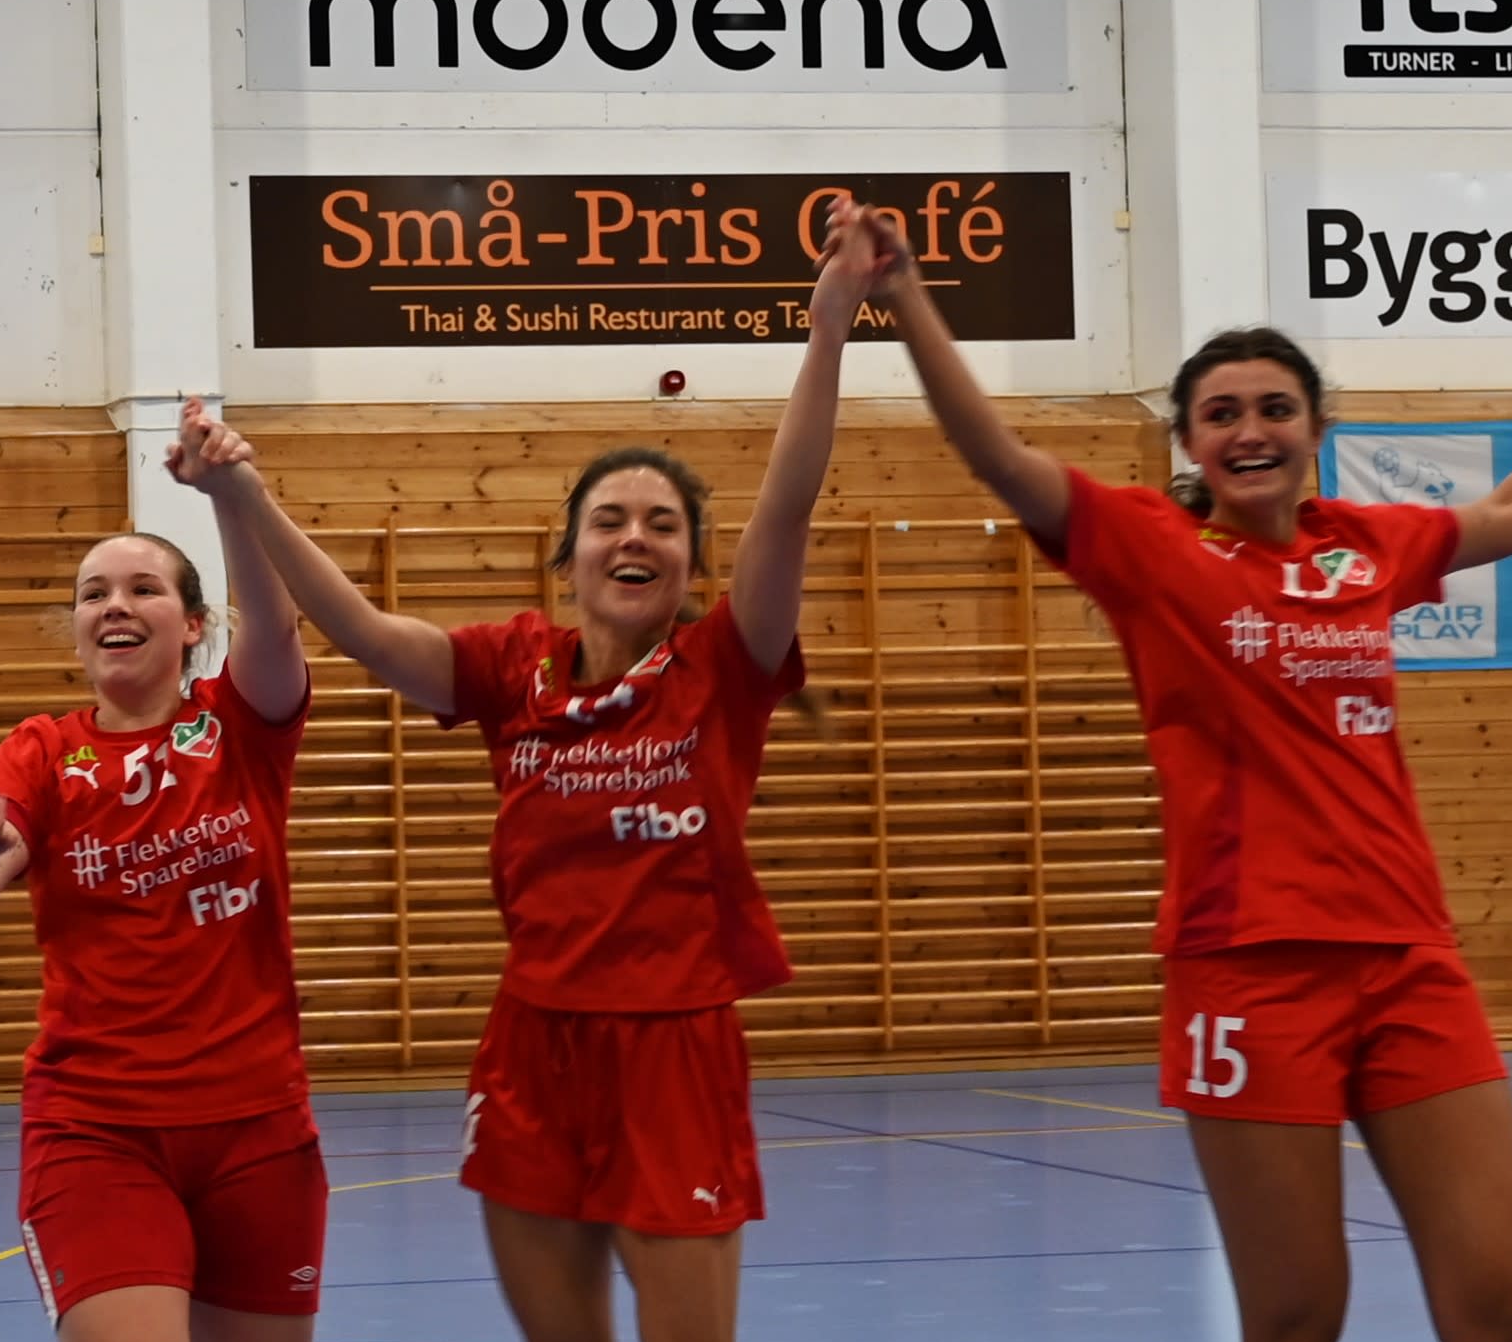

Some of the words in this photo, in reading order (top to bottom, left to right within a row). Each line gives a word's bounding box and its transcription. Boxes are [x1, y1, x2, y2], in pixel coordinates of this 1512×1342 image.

[1368, 52, 1456, 72] TURNER
[321, 181, 763, 270] Små-Pris
[401, 304, 465, 333] Thai
[474, 305, 497, 332] &
[506, 303, 580, 332] Sushi
[588, 303, 725, 331] Resturant
[733, 309, 769, 337] og
[610, 802, 707, 841] Fibo
[119, 831, 256, 898] Sparebank
[1185, 1012, 1247, 1099] 15
